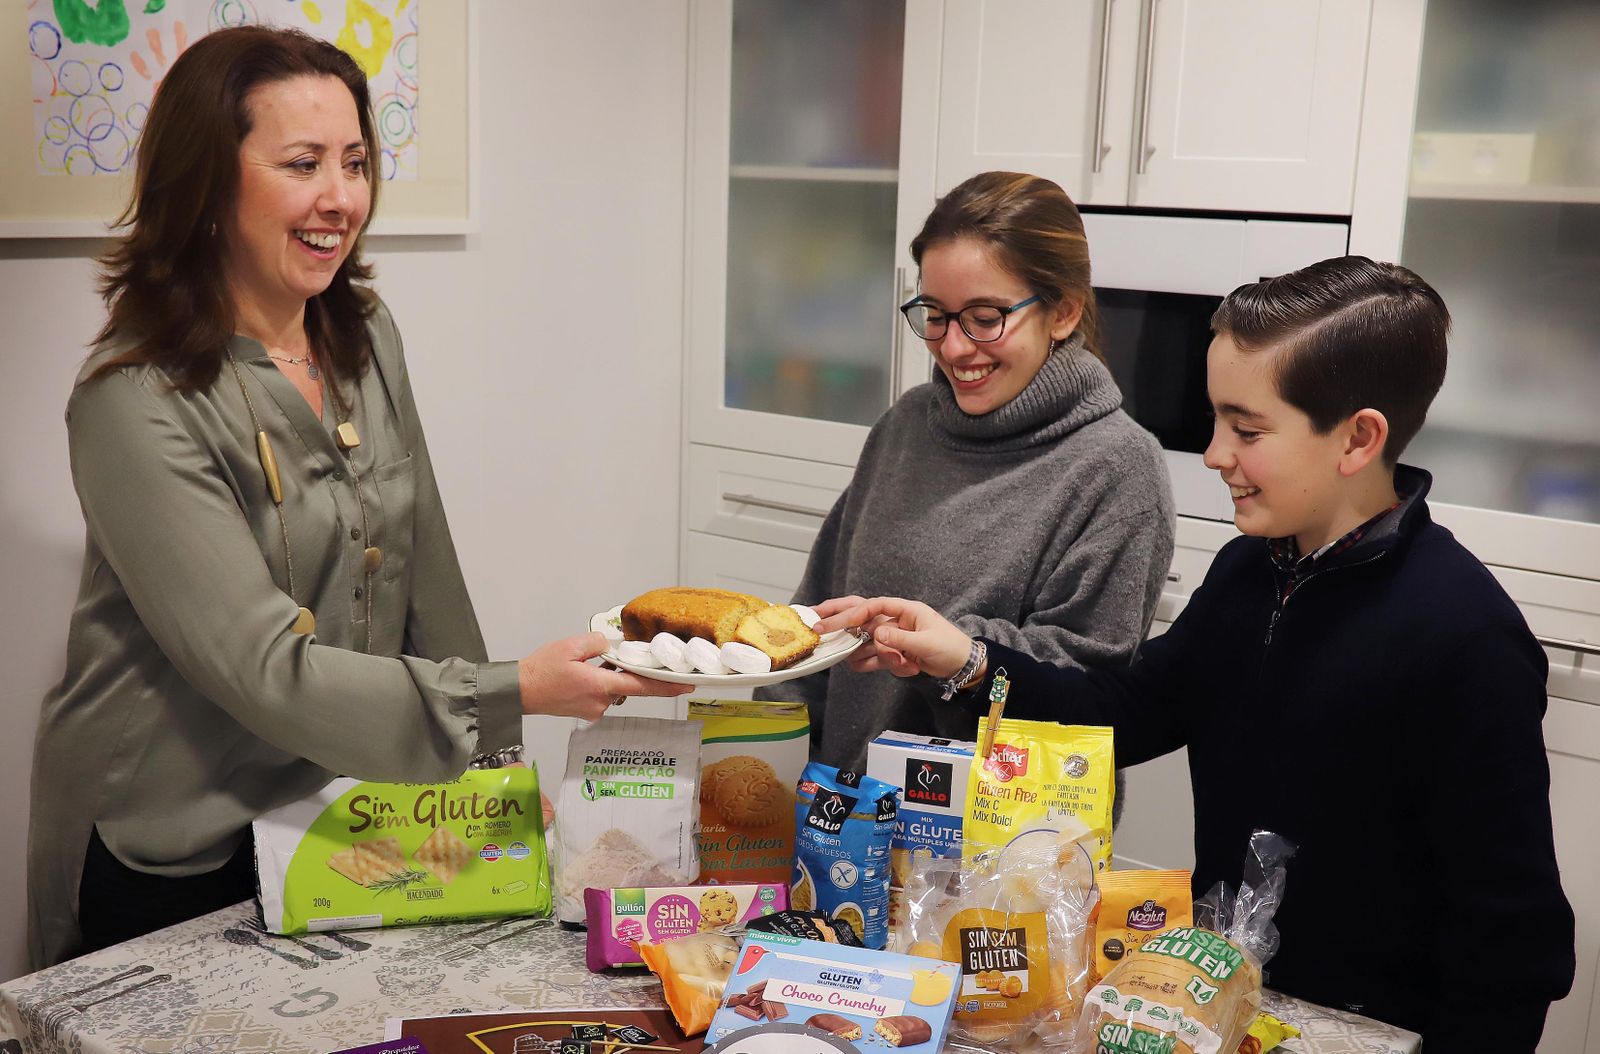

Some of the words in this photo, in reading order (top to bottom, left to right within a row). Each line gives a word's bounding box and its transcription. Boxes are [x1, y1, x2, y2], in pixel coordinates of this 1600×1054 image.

[600, 749, 665, 758] PREPARADO
[585, 756, 677, 766] PANIFICABLE
[583, 765, 676, 779] PANIFICAÇÃO
[602, 781, 616, 789] SIN
[620, 784, 670, 798] GLUTEN
[977, 780, 1011, 800] Gluten
[1015, 787, 1038, 803] Free
[600, 789, 617, 797] SEM
[908, 789, 947, 802] GALLO
[413, 789, 524, 829] Gluten
[974, 797, 990, 810] Mix
[992, 800, 1000, 811] C
[349, 794, 395, 833] Sin
[878, 813, 895, 821] GALLO
[972, 810, 989, 823] Mix
[990, 813, 1013, 827] Dolci
[808, 815, 842, 831] GALLO
[802, 827, 812, 839] Sin
[812, 832, 842, 847] Gluten
[909, 822, 963, 841] GLUTE
[725, 833, 785, 852] Gluten
[893, 833, 907, 841] ARA
[907, 836, 944, 847] MÚLTIPLES
[797, 839, 814, 852] DEOS
[814, 845, 852, 860] GRUESOS
[698, 854, 727, 871] Sin
[406, 888, 444, 900] HACENDADO
[491, 886, 501, 895] 6x
[313, 897, 331, 909] 200g
[616, 902, 645, 914] gullón
[1128, 910, 1166, 924] Noglut
[748, 931, 775, 941] mieux
[776, 935, 798, 945] vivre
[968, 930, 989, 949] SIN
[991, 931, 1018, 947] SEM
[1124, 932, 1139, 944] Sin
[1194, 931, 1243, 967] SEM
[969, 949, 1020, 970] GLUTEN
[1141, 938, 1232, 978] GLUTEN
[819, 971, 863, 986] GLUTEN
[781, 984, 824, 1002] Choco
[827, 992, 887, 1017] Crunchy
[1099, 1024, 1134, 1048] SIN
